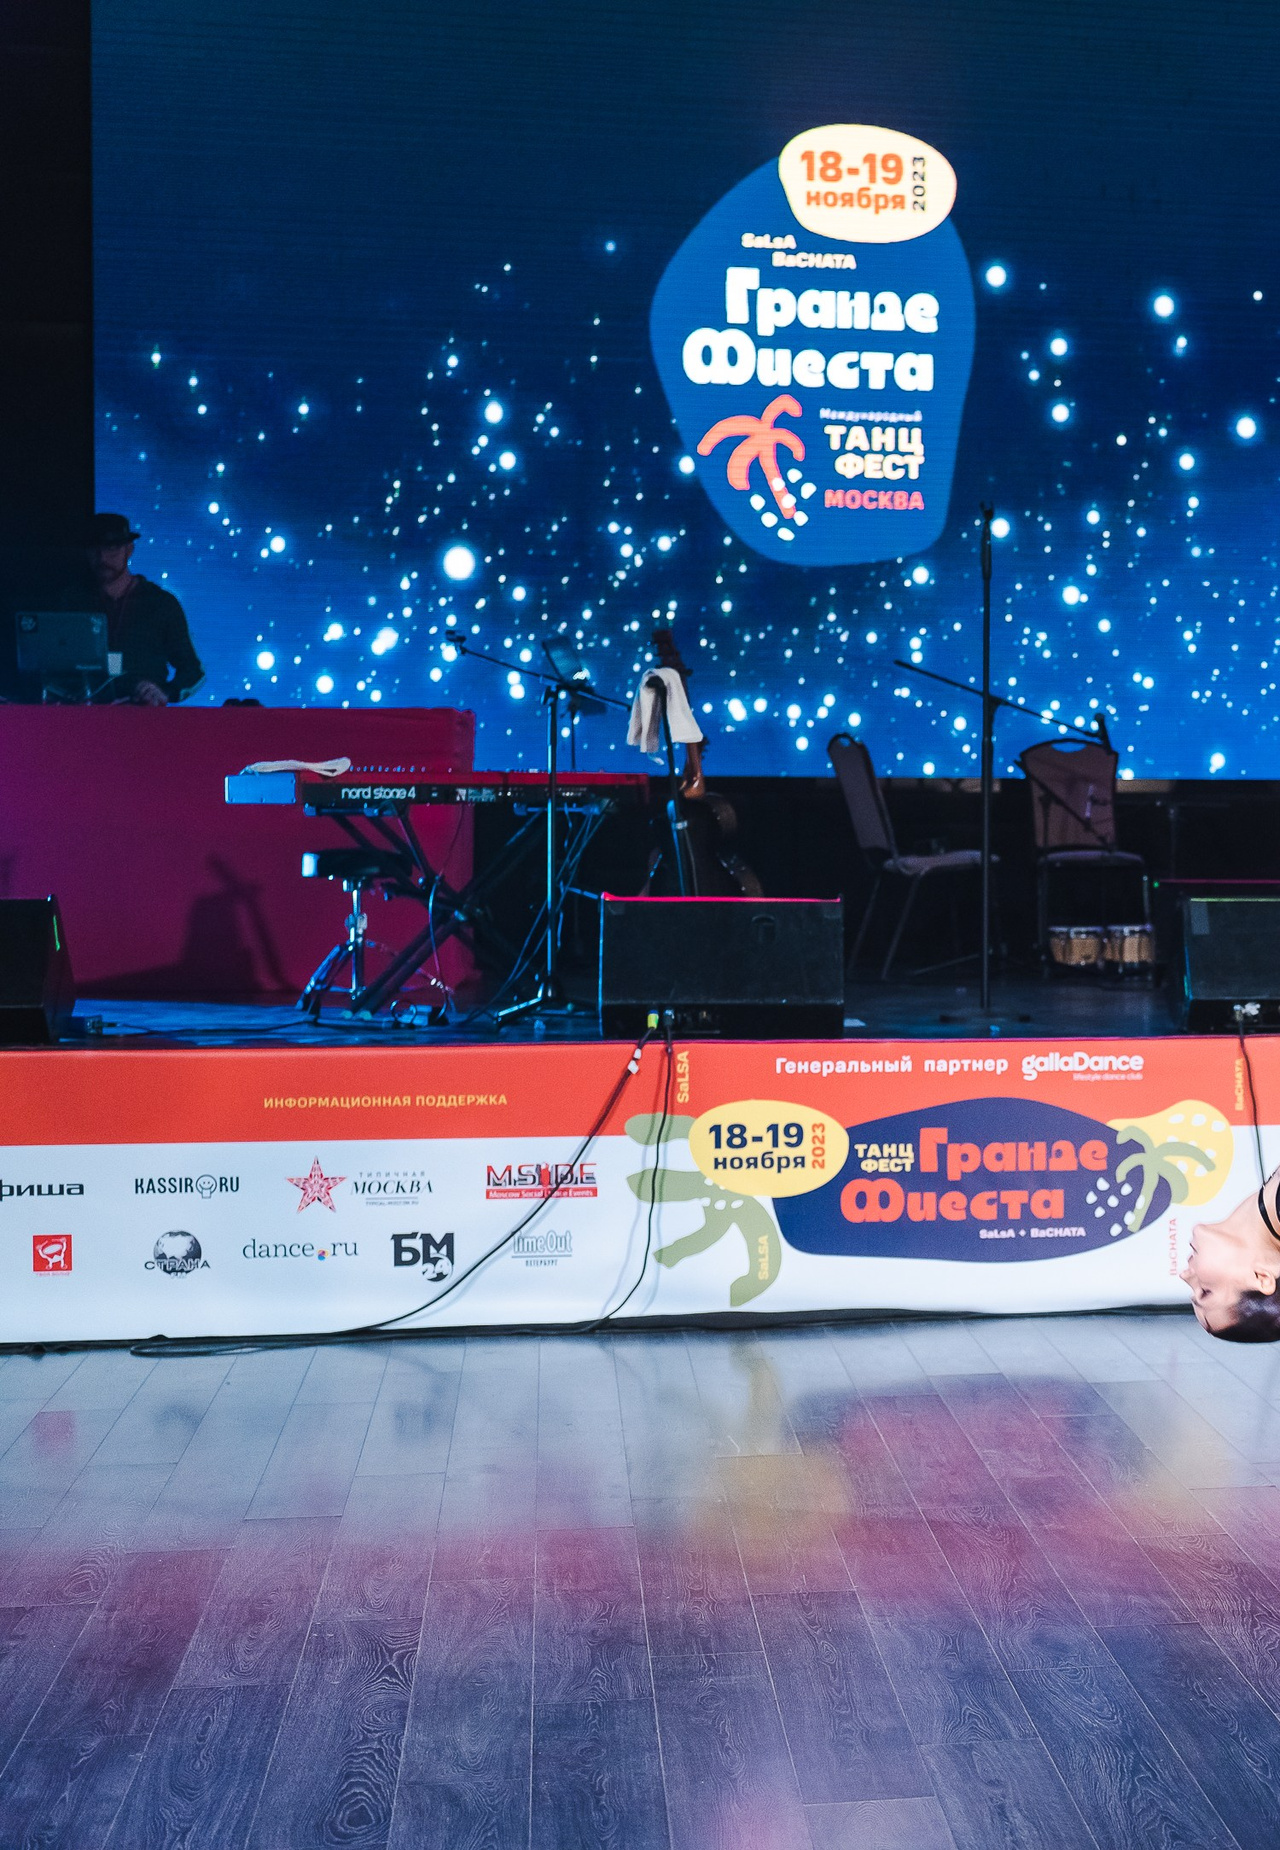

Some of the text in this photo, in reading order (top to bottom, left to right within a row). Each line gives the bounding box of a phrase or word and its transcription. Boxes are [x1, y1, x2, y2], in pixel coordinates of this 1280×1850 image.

[801, 150, 903, 185] 18-19
[912, 156, 925, 211] 2023
[806, 187, 905, 214] ноября
[726, 267, 939, 336] Гранде
[682, 327, 933, 391] Фиеста
[824, 425, 924, 456] ТАНЦ
[835, 452, 925, 480] ФЕСТ
[824, 489, 924, 510] МОСКВА
[341, 786, 372, 799] nord
[407, 786, 416, 799] 4
[776, 1055, 1008, 1077] Генеральный партнер
[1022, 1052, 1144, 1081] gallaDance
[264, 1094, 507, 1109] ИНФОРМАЦИОННАЯ ПОДДЕРЖКА
[709, 1123, 803, 1149] 18-19
[812, 1123, 825, 1169] 2023
[714, 1152, 805, 1173] ноября
[855, 1143, 914, 1161] ТАНЦ
[861, 1157, 914, 1173] ФЕСТ
[920, 1127, 1108, 1181] Гранде
[351, 1180, 433, 1195] МОСКВА
[840, 1178, 1064, 1223] Фиеста
[391, 1231, 454, 1267] БМ
[144, 1259, 211, 1271] СТРАНА
